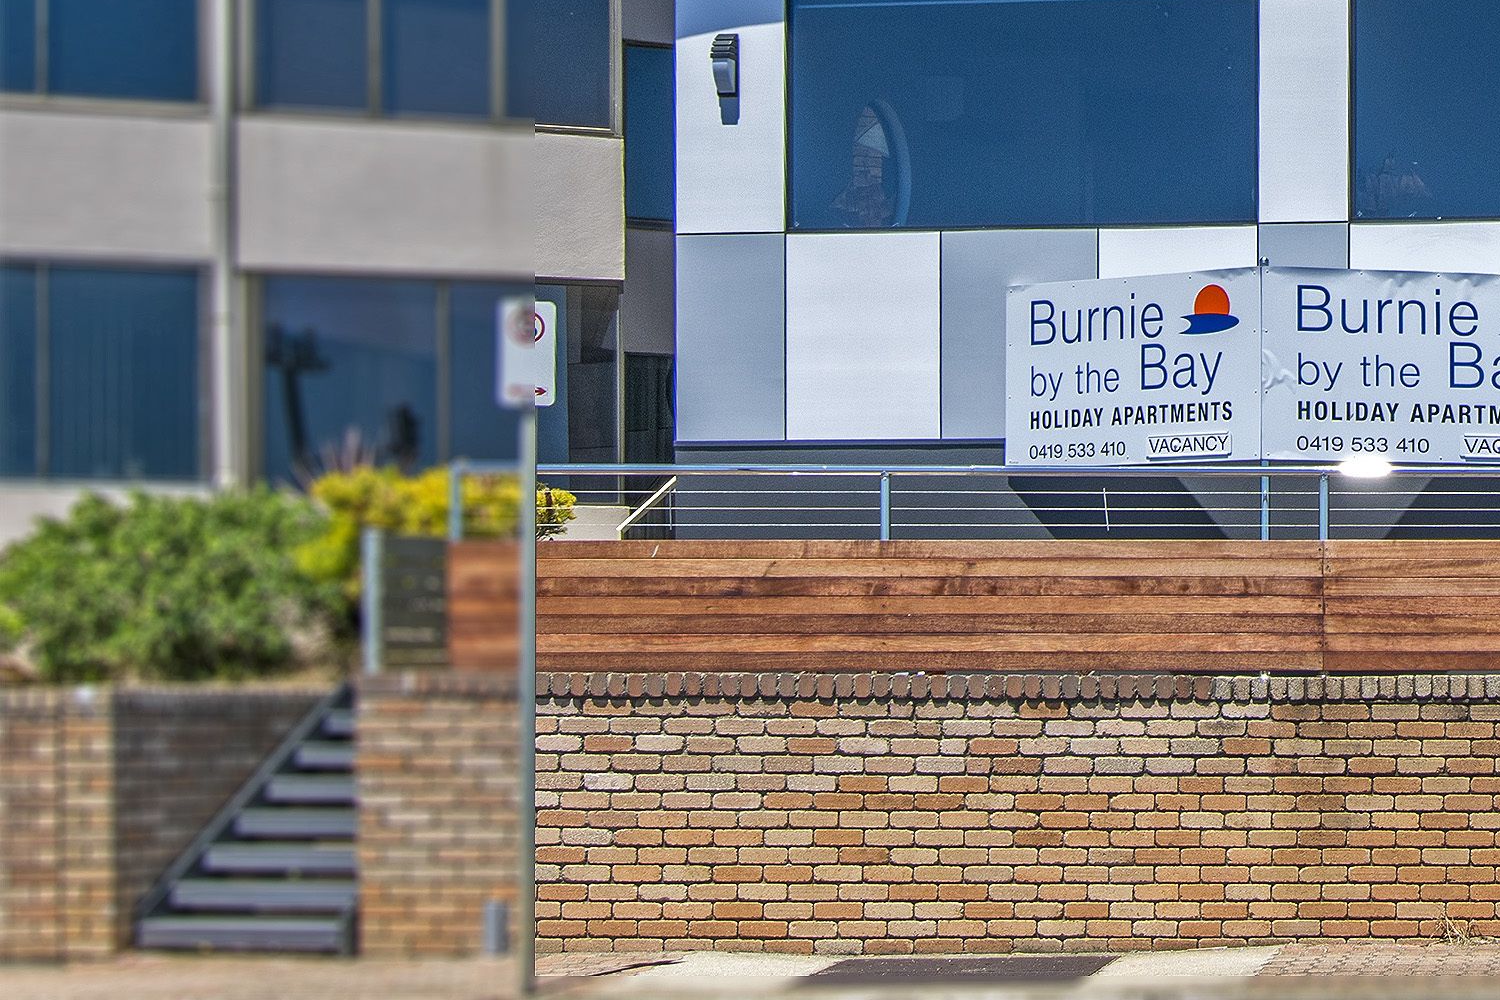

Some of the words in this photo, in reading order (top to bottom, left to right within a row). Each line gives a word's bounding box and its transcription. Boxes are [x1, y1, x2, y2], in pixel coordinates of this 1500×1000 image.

[1030, 292, 1164, 346] Burnie
[1297, 284, 1479, 336] Burnie
[1031, 365, 1063, 401] by
[1075, 362, 1120, 394] the
[1141, 343, 1222, 395] Bay
[1297, 352, 1343, 391] by
[1360, 355, 1421, 388] the
[1030, 408, 1104, 430] HOLIDAY
[1111, 401, 1233, 426] APARTMENTS
[1297, 401, 1399, 422] HOLIDAY
[1029, 444, 1063, 460] 0419
[1067, 442, 1096, 458] 533
[1100, 441, 1126, 457] 410
[1149, 435, 1229, 453] VACANCY
[1296, 436, 1343, 452] 0419
[1351, 437, 1388, 453] 533
[1396, 438, 1430, 454] 410
